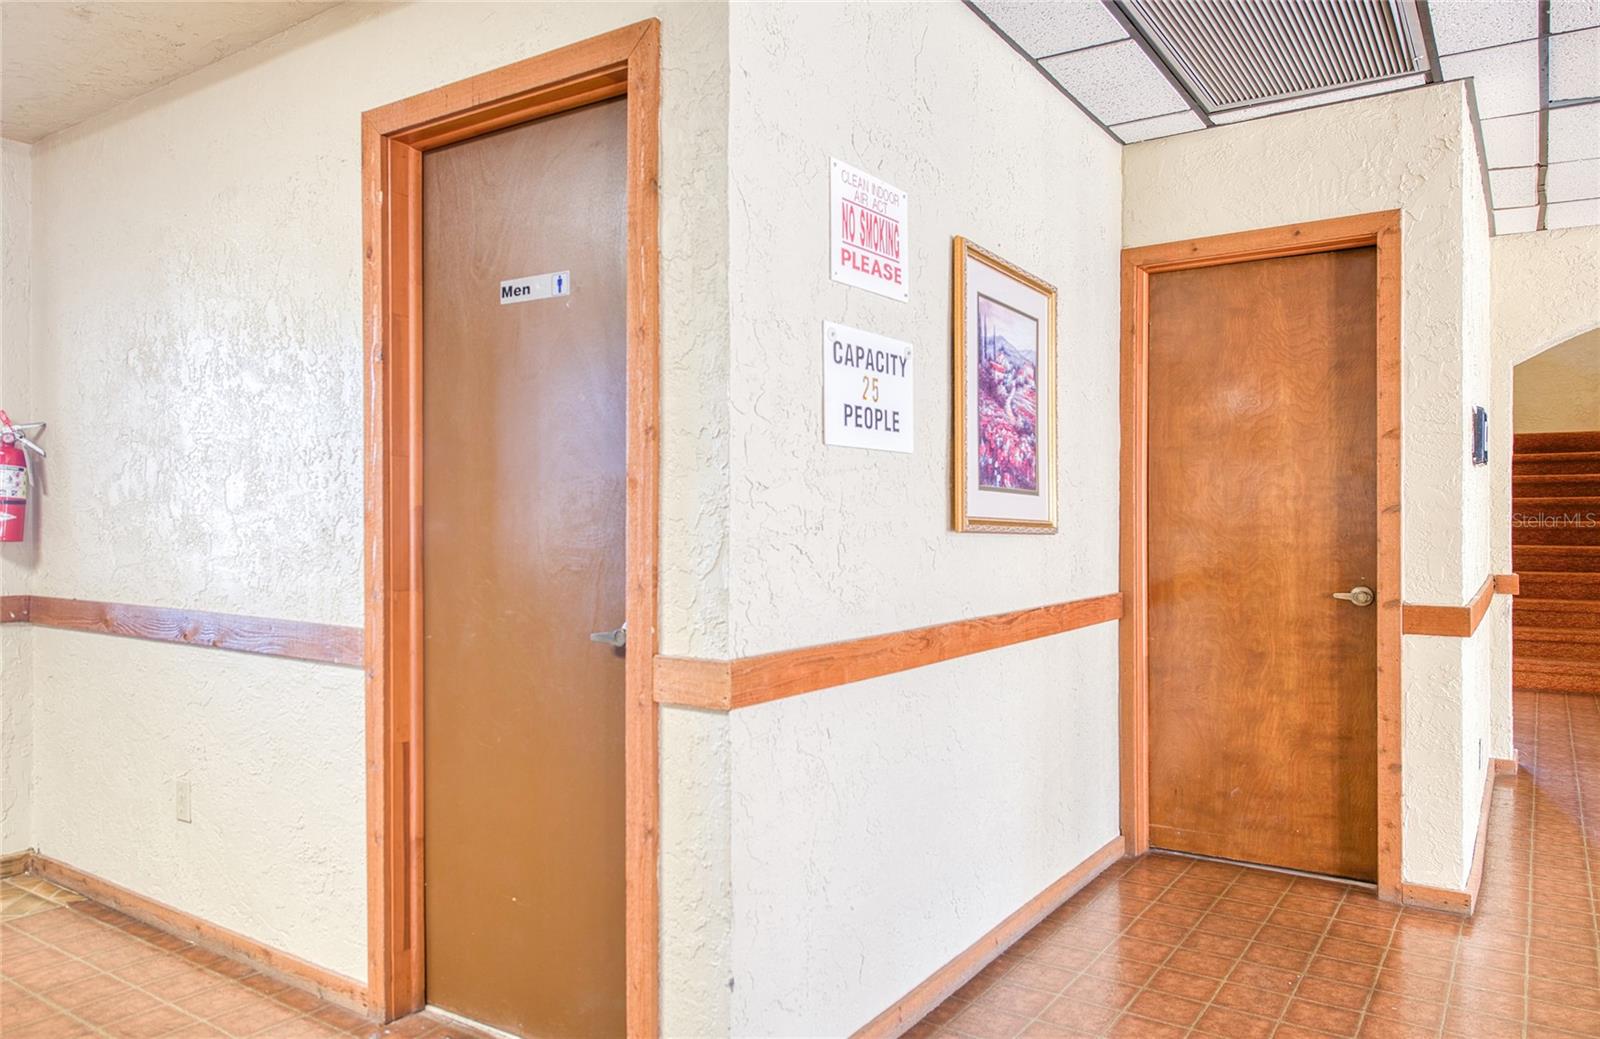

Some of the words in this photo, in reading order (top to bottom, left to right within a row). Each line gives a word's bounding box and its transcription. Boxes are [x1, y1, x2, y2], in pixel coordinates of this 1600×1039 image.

[841, 169, 869, 193] CLEAN
[872, 182, 899, 208] INDOOR
[854, 190, 868, 207] AIR
[872, 198, 888, 214] ACT
[841, 201, 855, 243] NO
[860, 209, 900, 259] SMOKING
[841, 247, 902, 285] PLEASE
[502, 285, 531, 299] Men
[833, 340, 907, 378] CAPACITY
[862, 375, 879, 403] 25
[843, 403, 900, 433] PEOPLE
